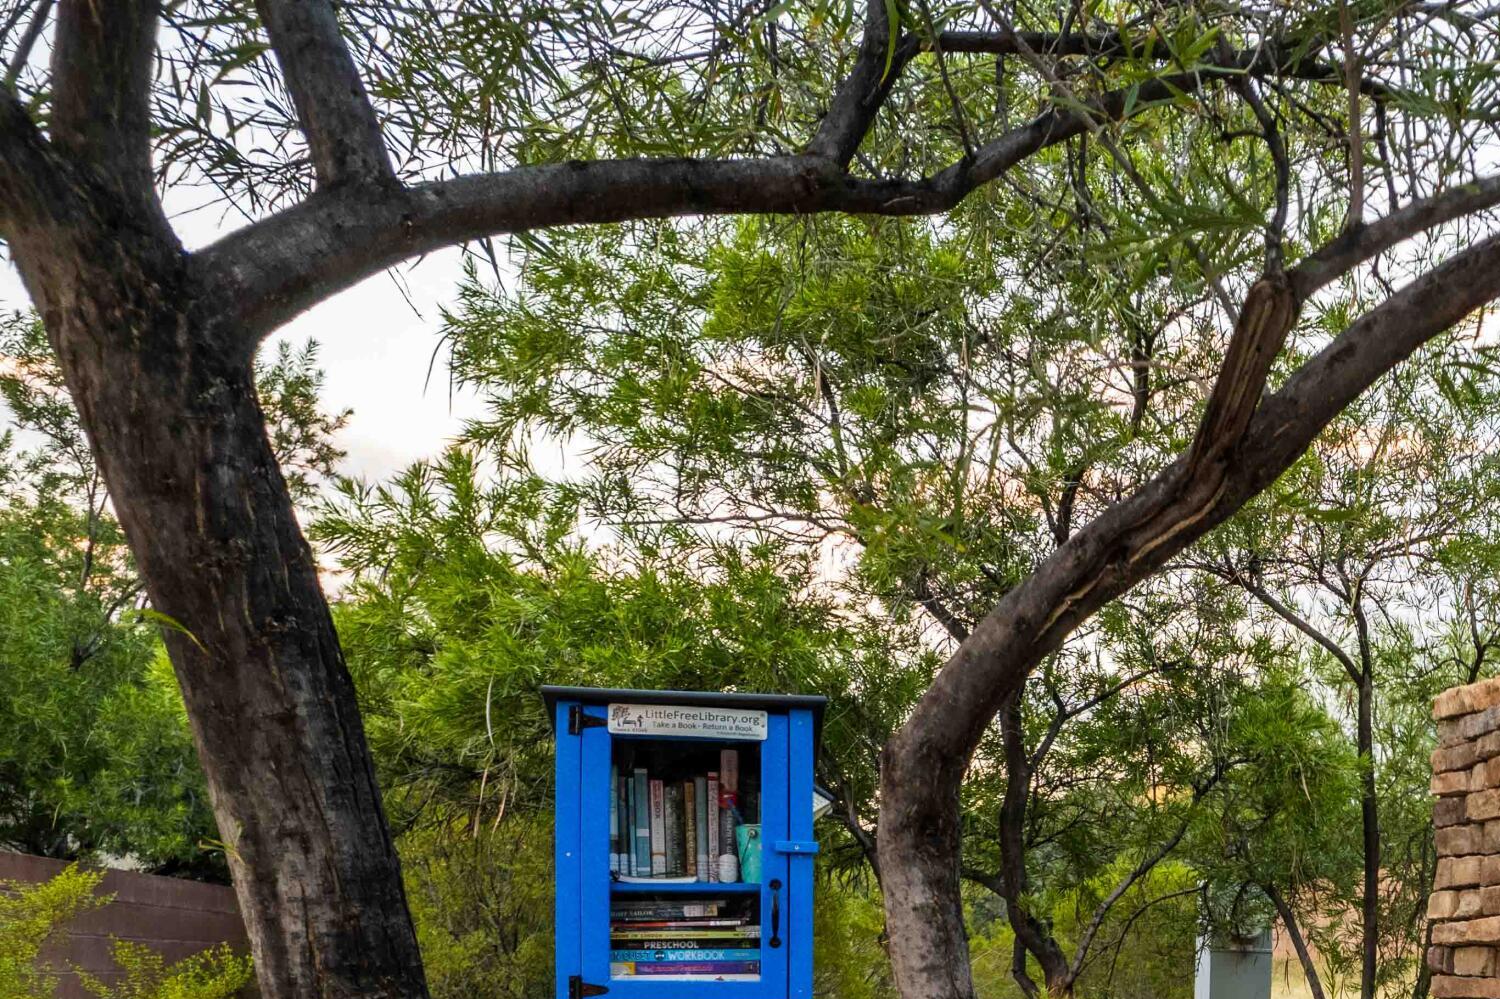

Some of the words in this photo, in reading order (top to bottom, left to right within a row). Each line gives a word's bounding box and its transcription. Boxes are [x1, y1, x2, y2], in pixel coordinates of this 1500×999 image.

[645, 709, 760, 726] LittleFreeLibrary.org
[653, 721, 670, 729] Take
[678, 721, 697, 729] Book
[703, 722, 728, 731] Return
[735, 724, 753, 732] Book
[644, 941, 699, 949] PRESCHOOL
[667, 951, 725, 960] WORKBOOK
